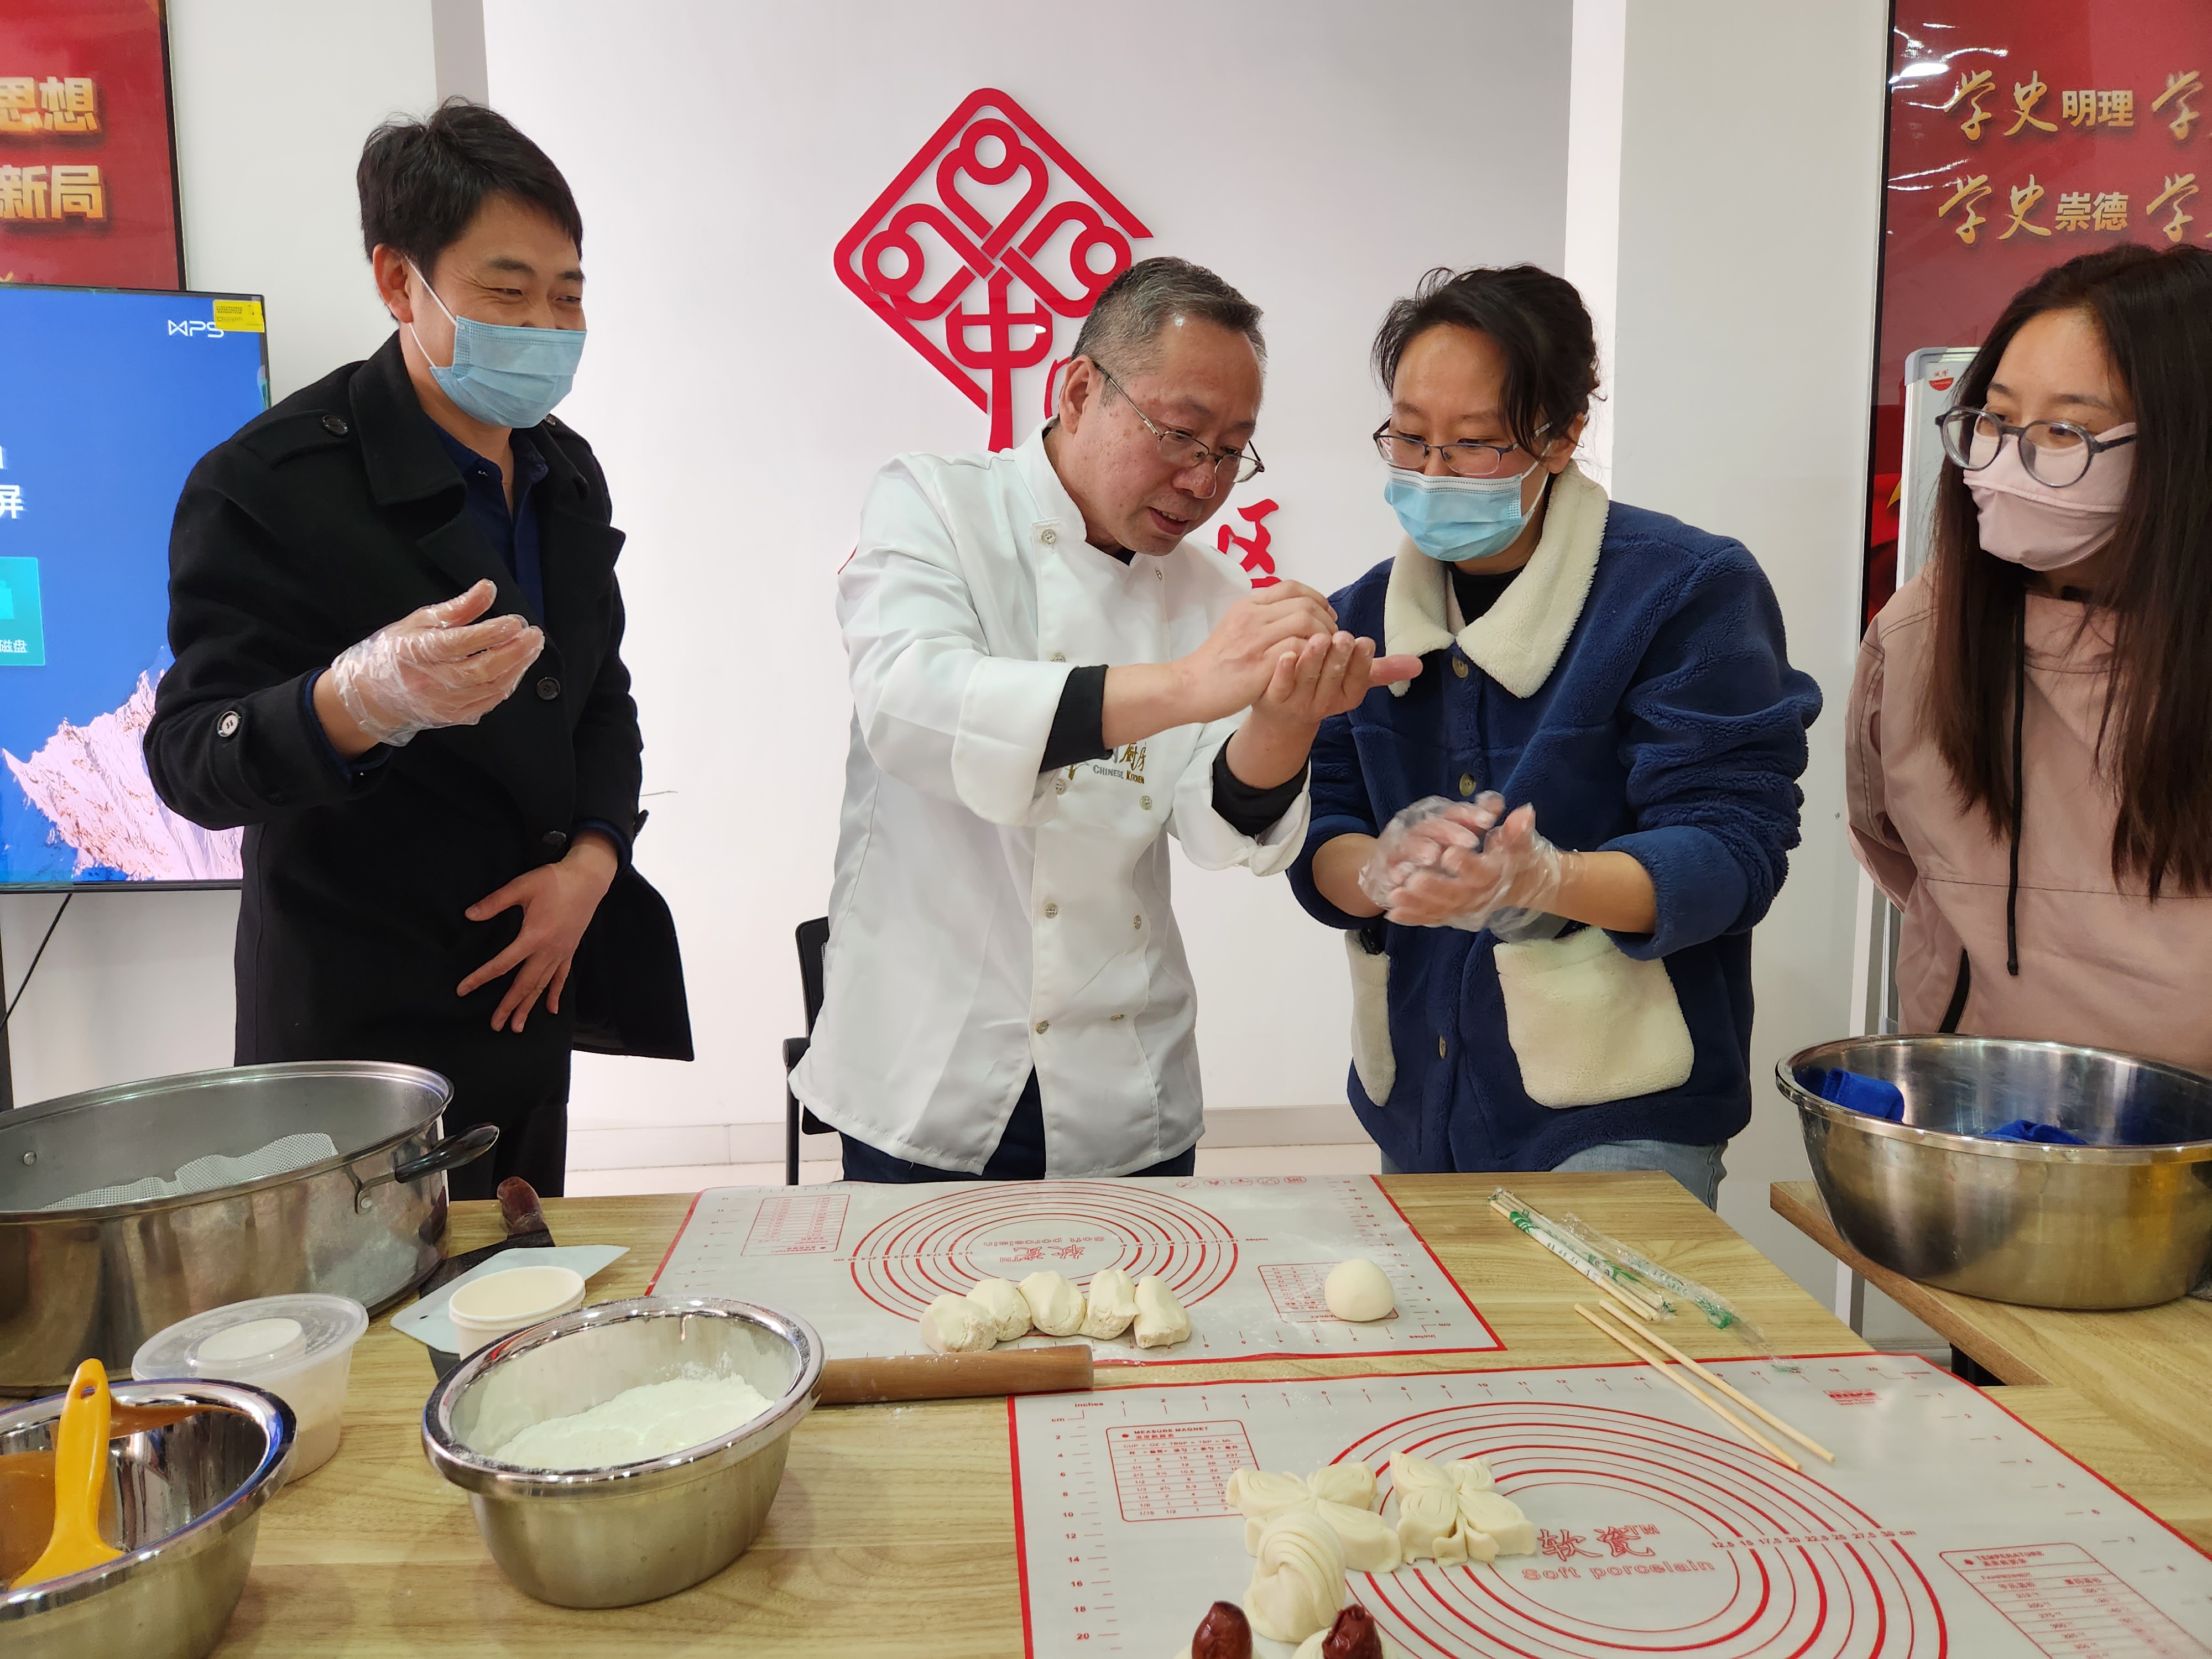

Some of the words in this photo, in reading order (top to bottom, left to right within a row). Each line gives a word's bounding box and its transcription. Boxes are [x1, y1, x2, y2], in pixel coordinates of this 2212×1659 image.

[0, 76, 97, 131] 思想
[1944, 70, 2134, 140] 学史明理
[0, 164, 105, 218] 新局
[1939, 174, 2128, 244] 学史崇德
[1093, 765, 1124, 779] CHINESE
[983, 1237, 1062, 1246] porcelain
[1537, 1526, 1656, 1562] 软瓷
[1522, 1566, 1581, 1580] Soft
[1589, 1559, 1715, 1579] porcelain
